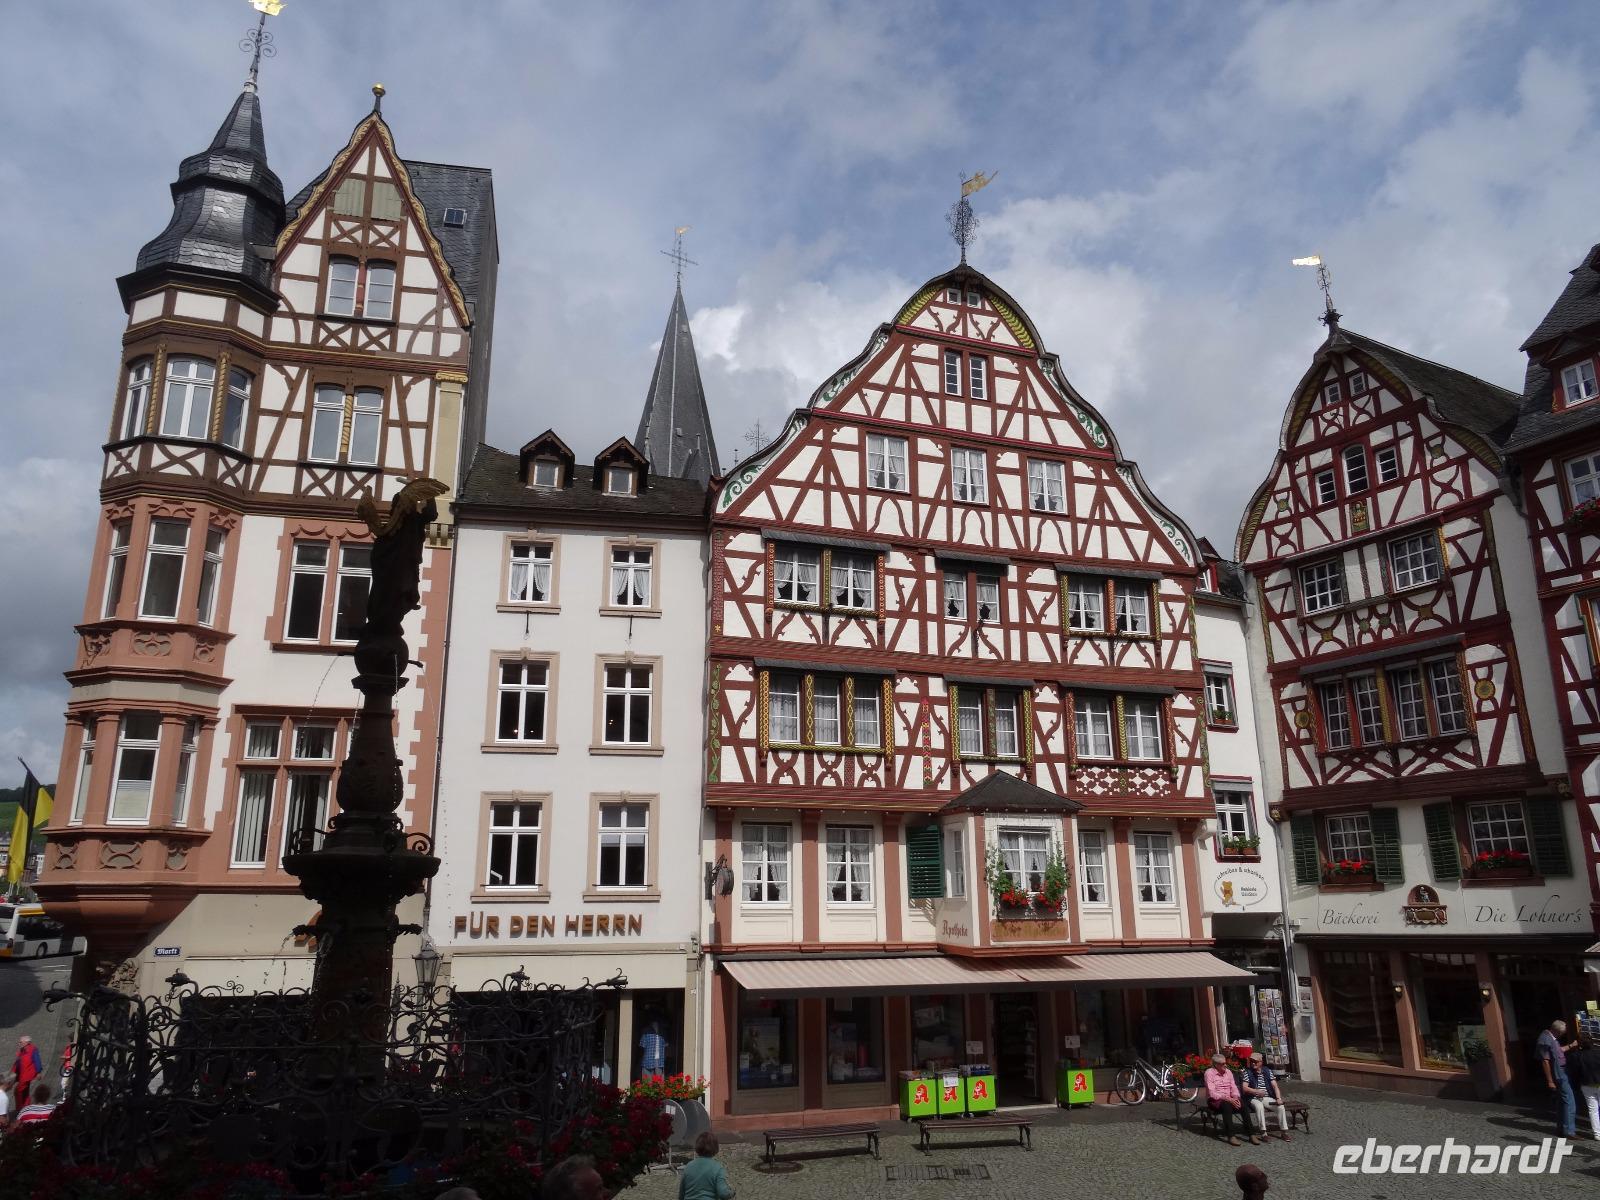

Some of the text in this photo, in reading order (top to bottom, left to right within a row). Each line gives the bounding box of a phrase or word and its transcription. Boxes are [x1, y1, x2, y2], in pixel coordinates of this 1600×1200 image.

[1322, 902, 1381, 925] Bäckerei
[1475, 905, 1508, 923] Die
[509, 915, 555, 938] DEN
[564, 914, 643, 937] HERRN
